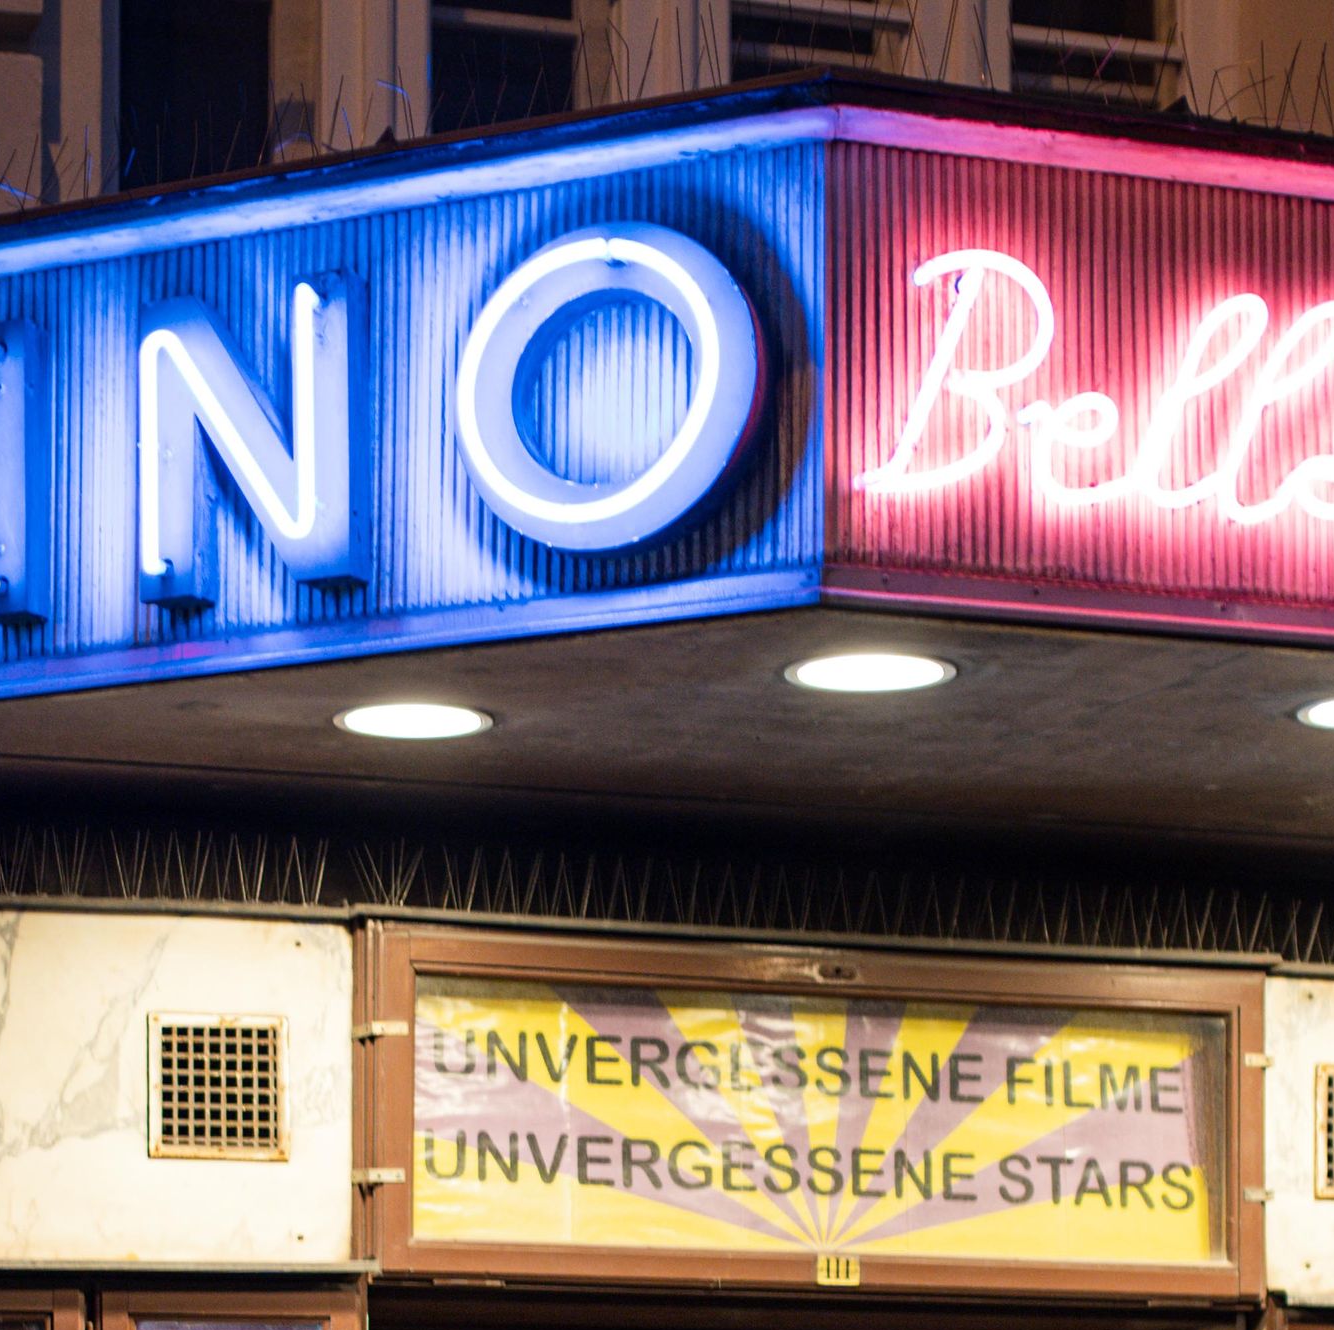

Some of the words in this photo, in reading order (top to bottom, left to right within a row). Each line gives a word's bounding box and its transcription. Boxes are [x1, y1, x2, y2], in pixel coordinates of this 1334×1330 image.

[432, 1028, 985, 1104] UNVERGESSENE
[1005, 1056, 1185, 1116] FILME
[423, 1128, 978, 1203] UNVERGESSENE
[998, 1154, 1196, 1212] STARS
